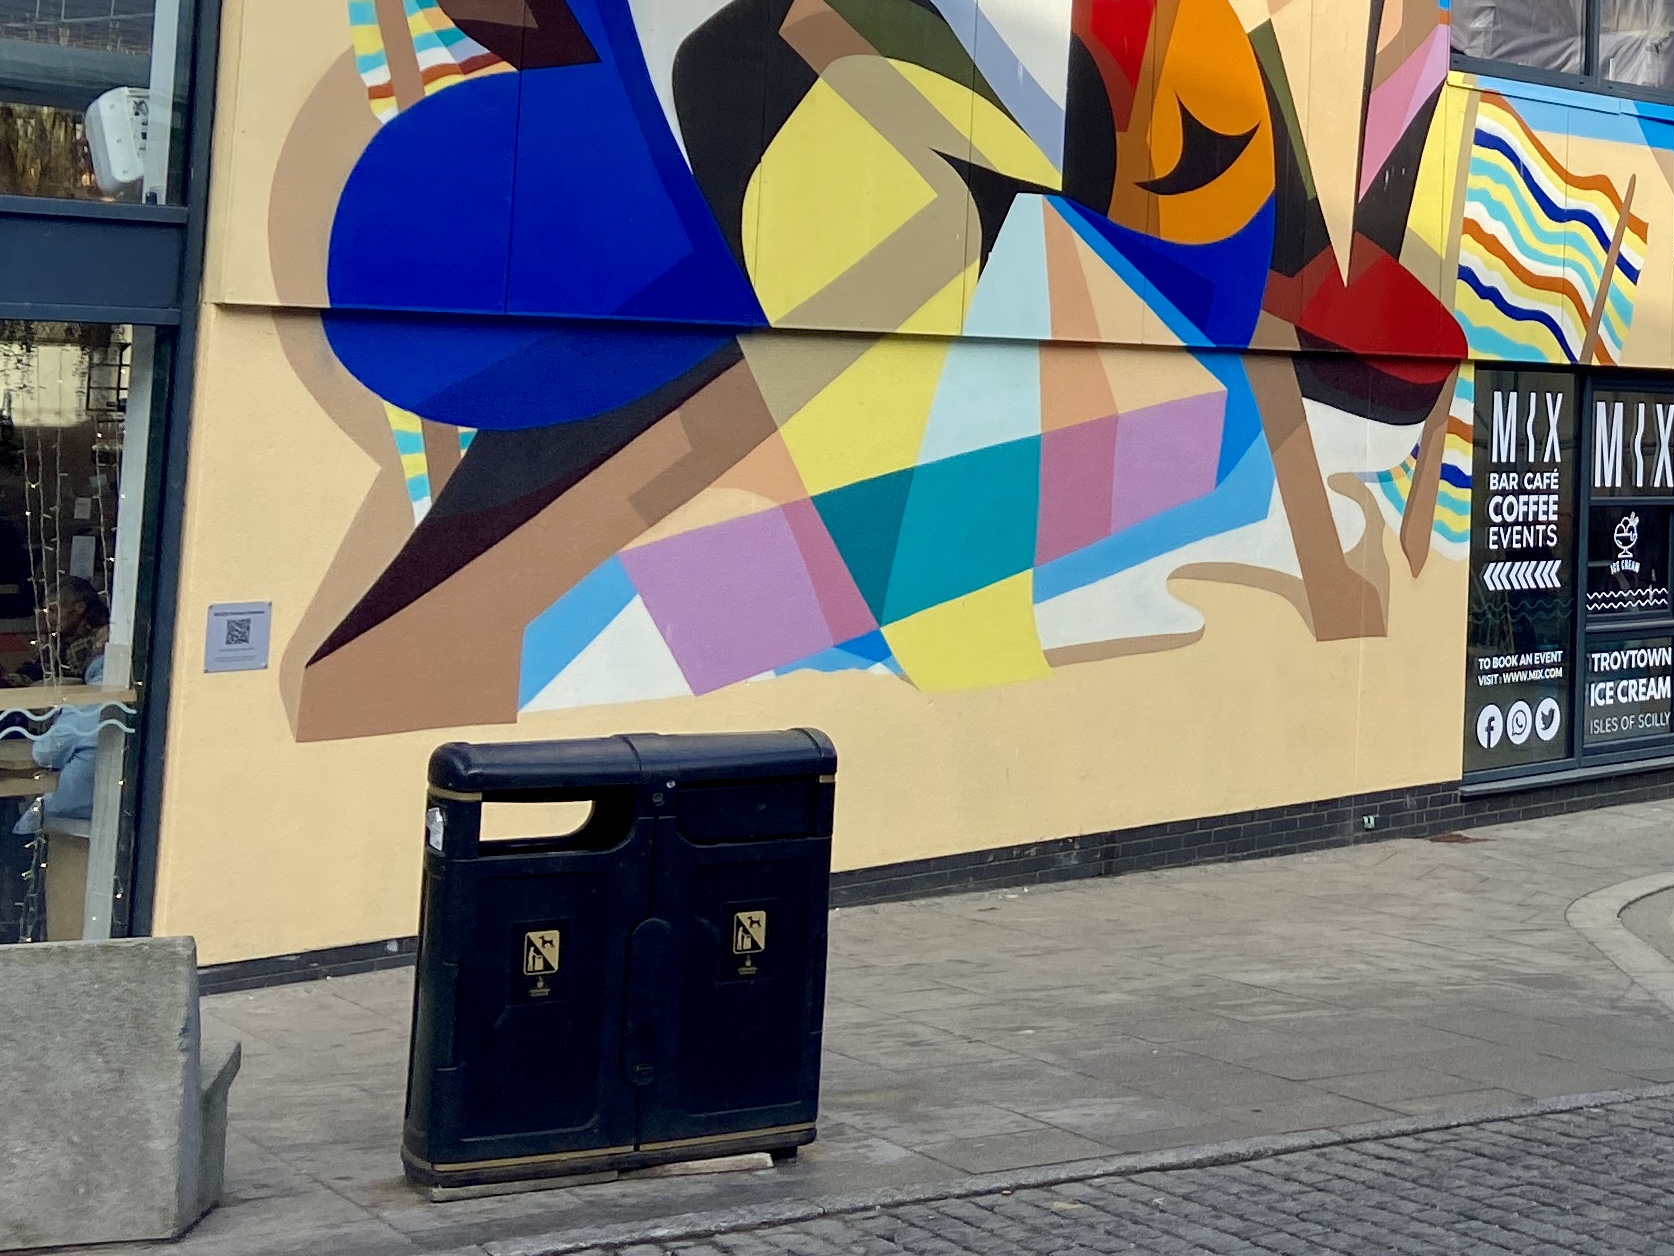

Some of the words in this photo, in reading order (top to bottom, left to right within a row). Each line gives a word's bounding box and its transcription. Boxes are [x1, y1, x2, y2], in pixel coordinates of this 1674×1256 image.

[1492, 391, 1563, 463] MIX
[1489, 473, 1518, 490] BAR
[1524, 467, 1559, 490] CAFÉ
[1488, 494, 1559, 523] COFFEE
[1488, 524, 1558, 550] EVENTS
[1478, 657, 1491, 671] TO
[1492, 654, 1519, 669] BOOK
[1519, 652, 1533, 666] AN
[1534, 650, 1564, 665] EVENT
[1591, 647, 1672, 672] TROYTOWN
[1502, 666, 1564, 685] WWW.MIX.COM
[1590, 681, 1615, 707] ICE
[1616, 675, 1672, 704] CREAM
[1590, 717, 1619, 735] ISLES
[1620, 714, 1635, 731] OF
[1637, 711, 1672, 729] SCILLY
